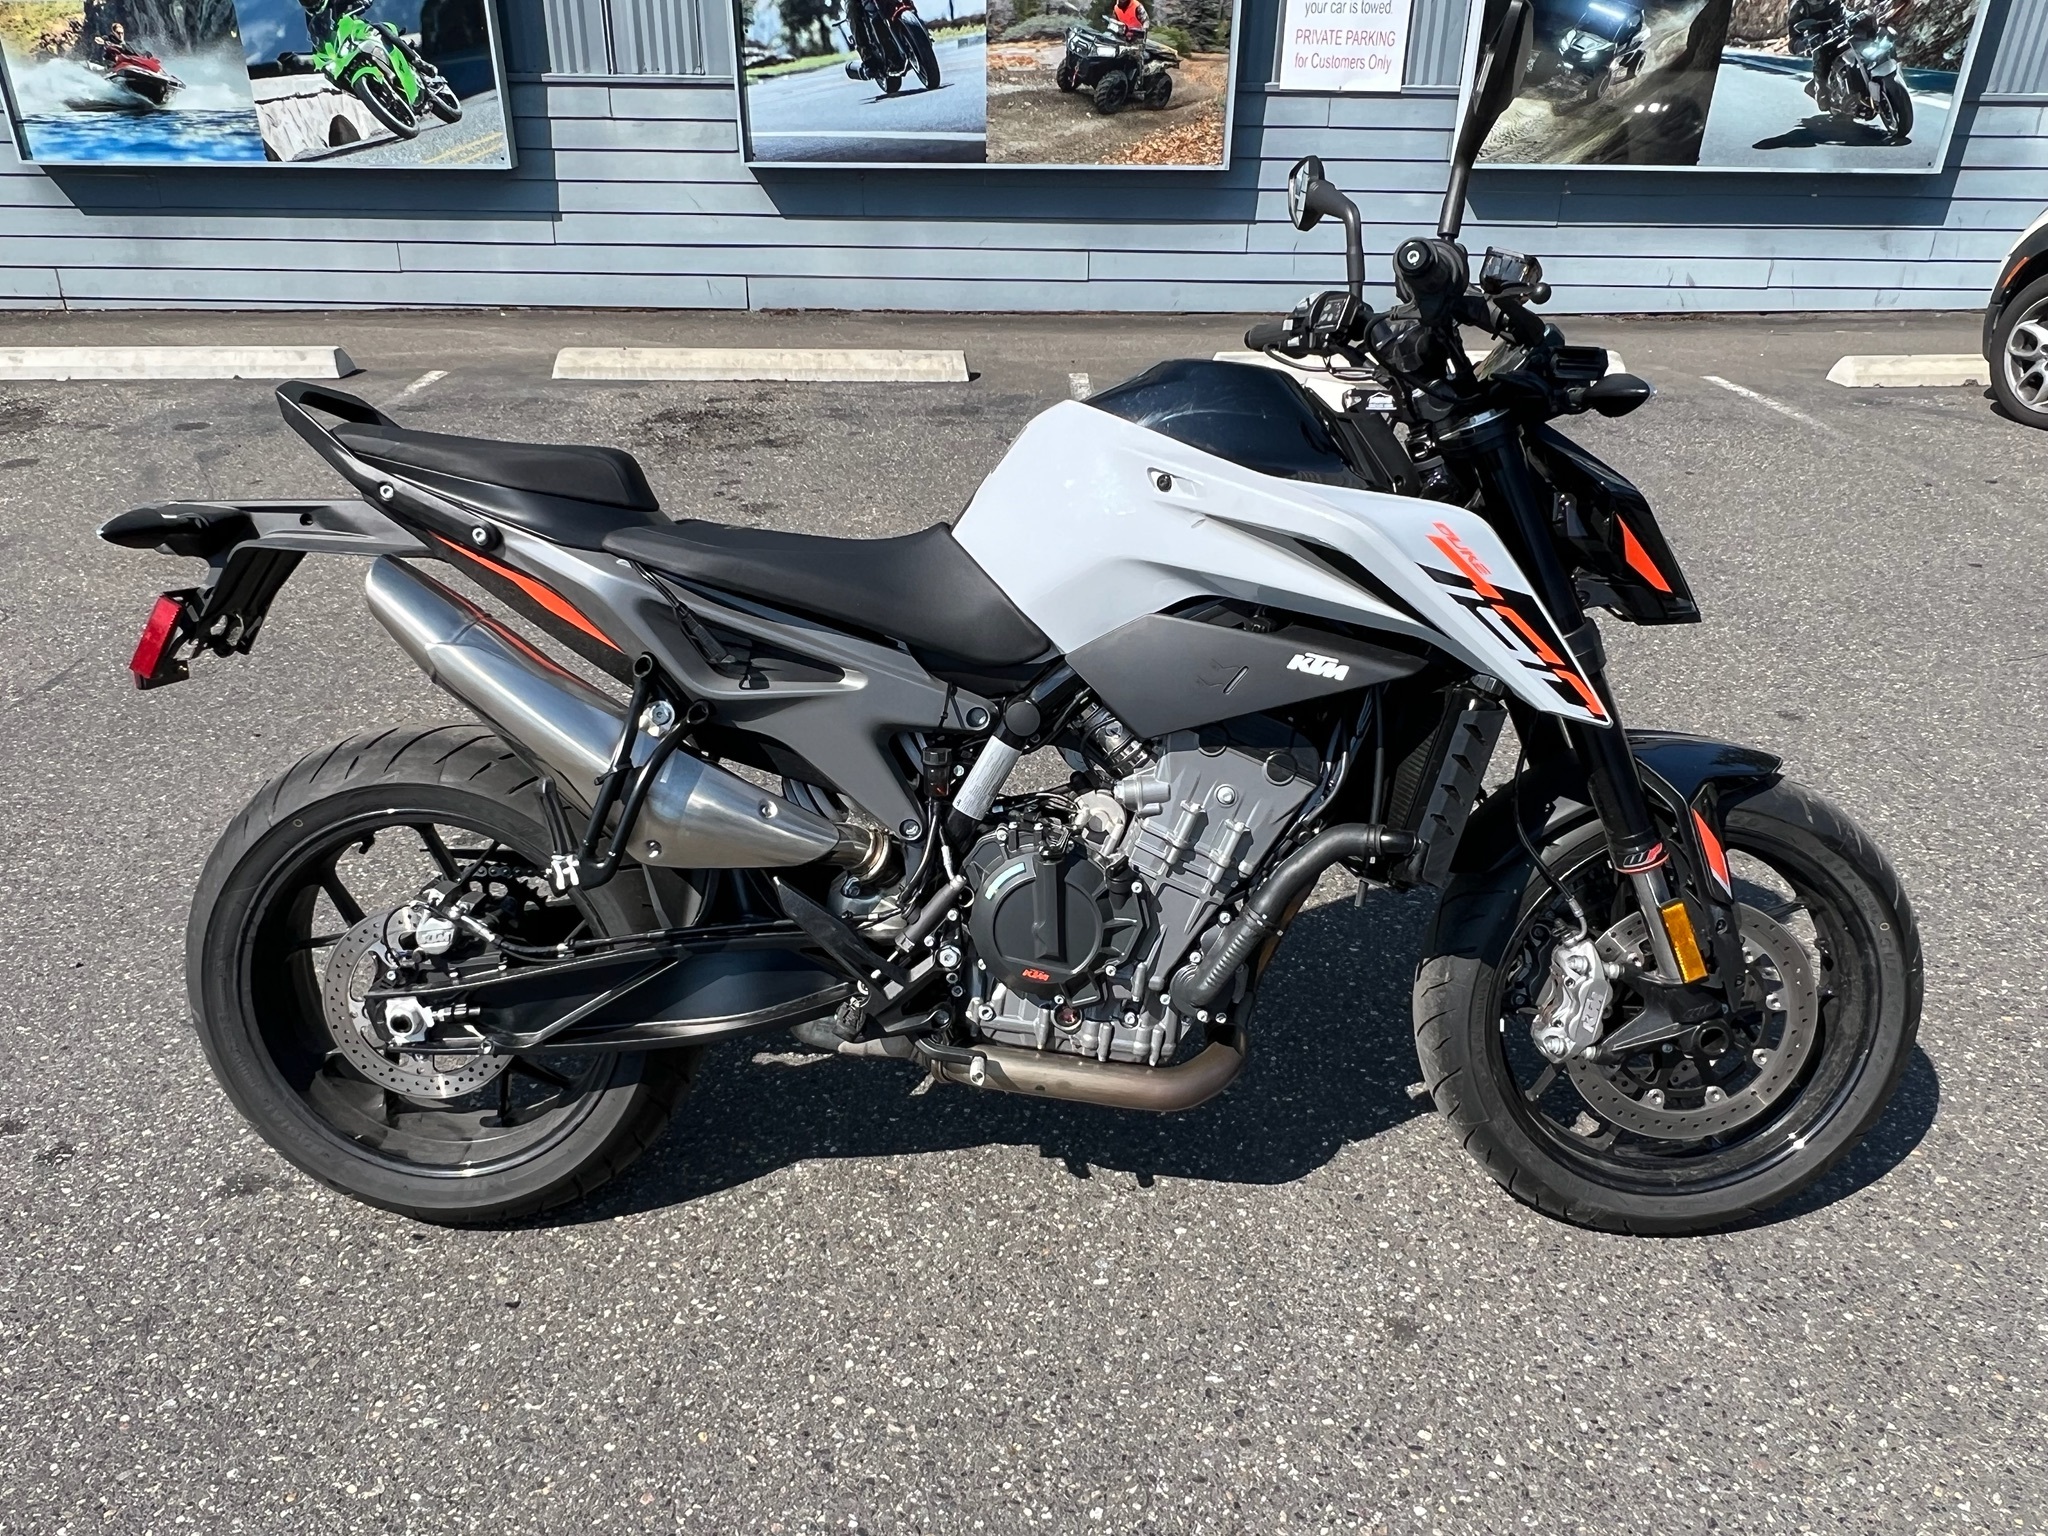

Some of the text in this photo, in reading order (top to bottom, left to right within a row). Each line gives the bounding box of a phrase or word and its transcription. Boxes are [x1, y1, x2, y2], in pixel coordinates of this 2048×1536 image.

[1304, 0, 1393, 18] your car is towed.
[1295, 29, 1396, 47] PRIVATE PARKING
[1294, 52, 1392, 75] for Customers Only
[1432, 522, 1492, 576] DUKE
[1286, 652, 1350, 681] KTM
[1022, 968, 1050, 981] KTM
